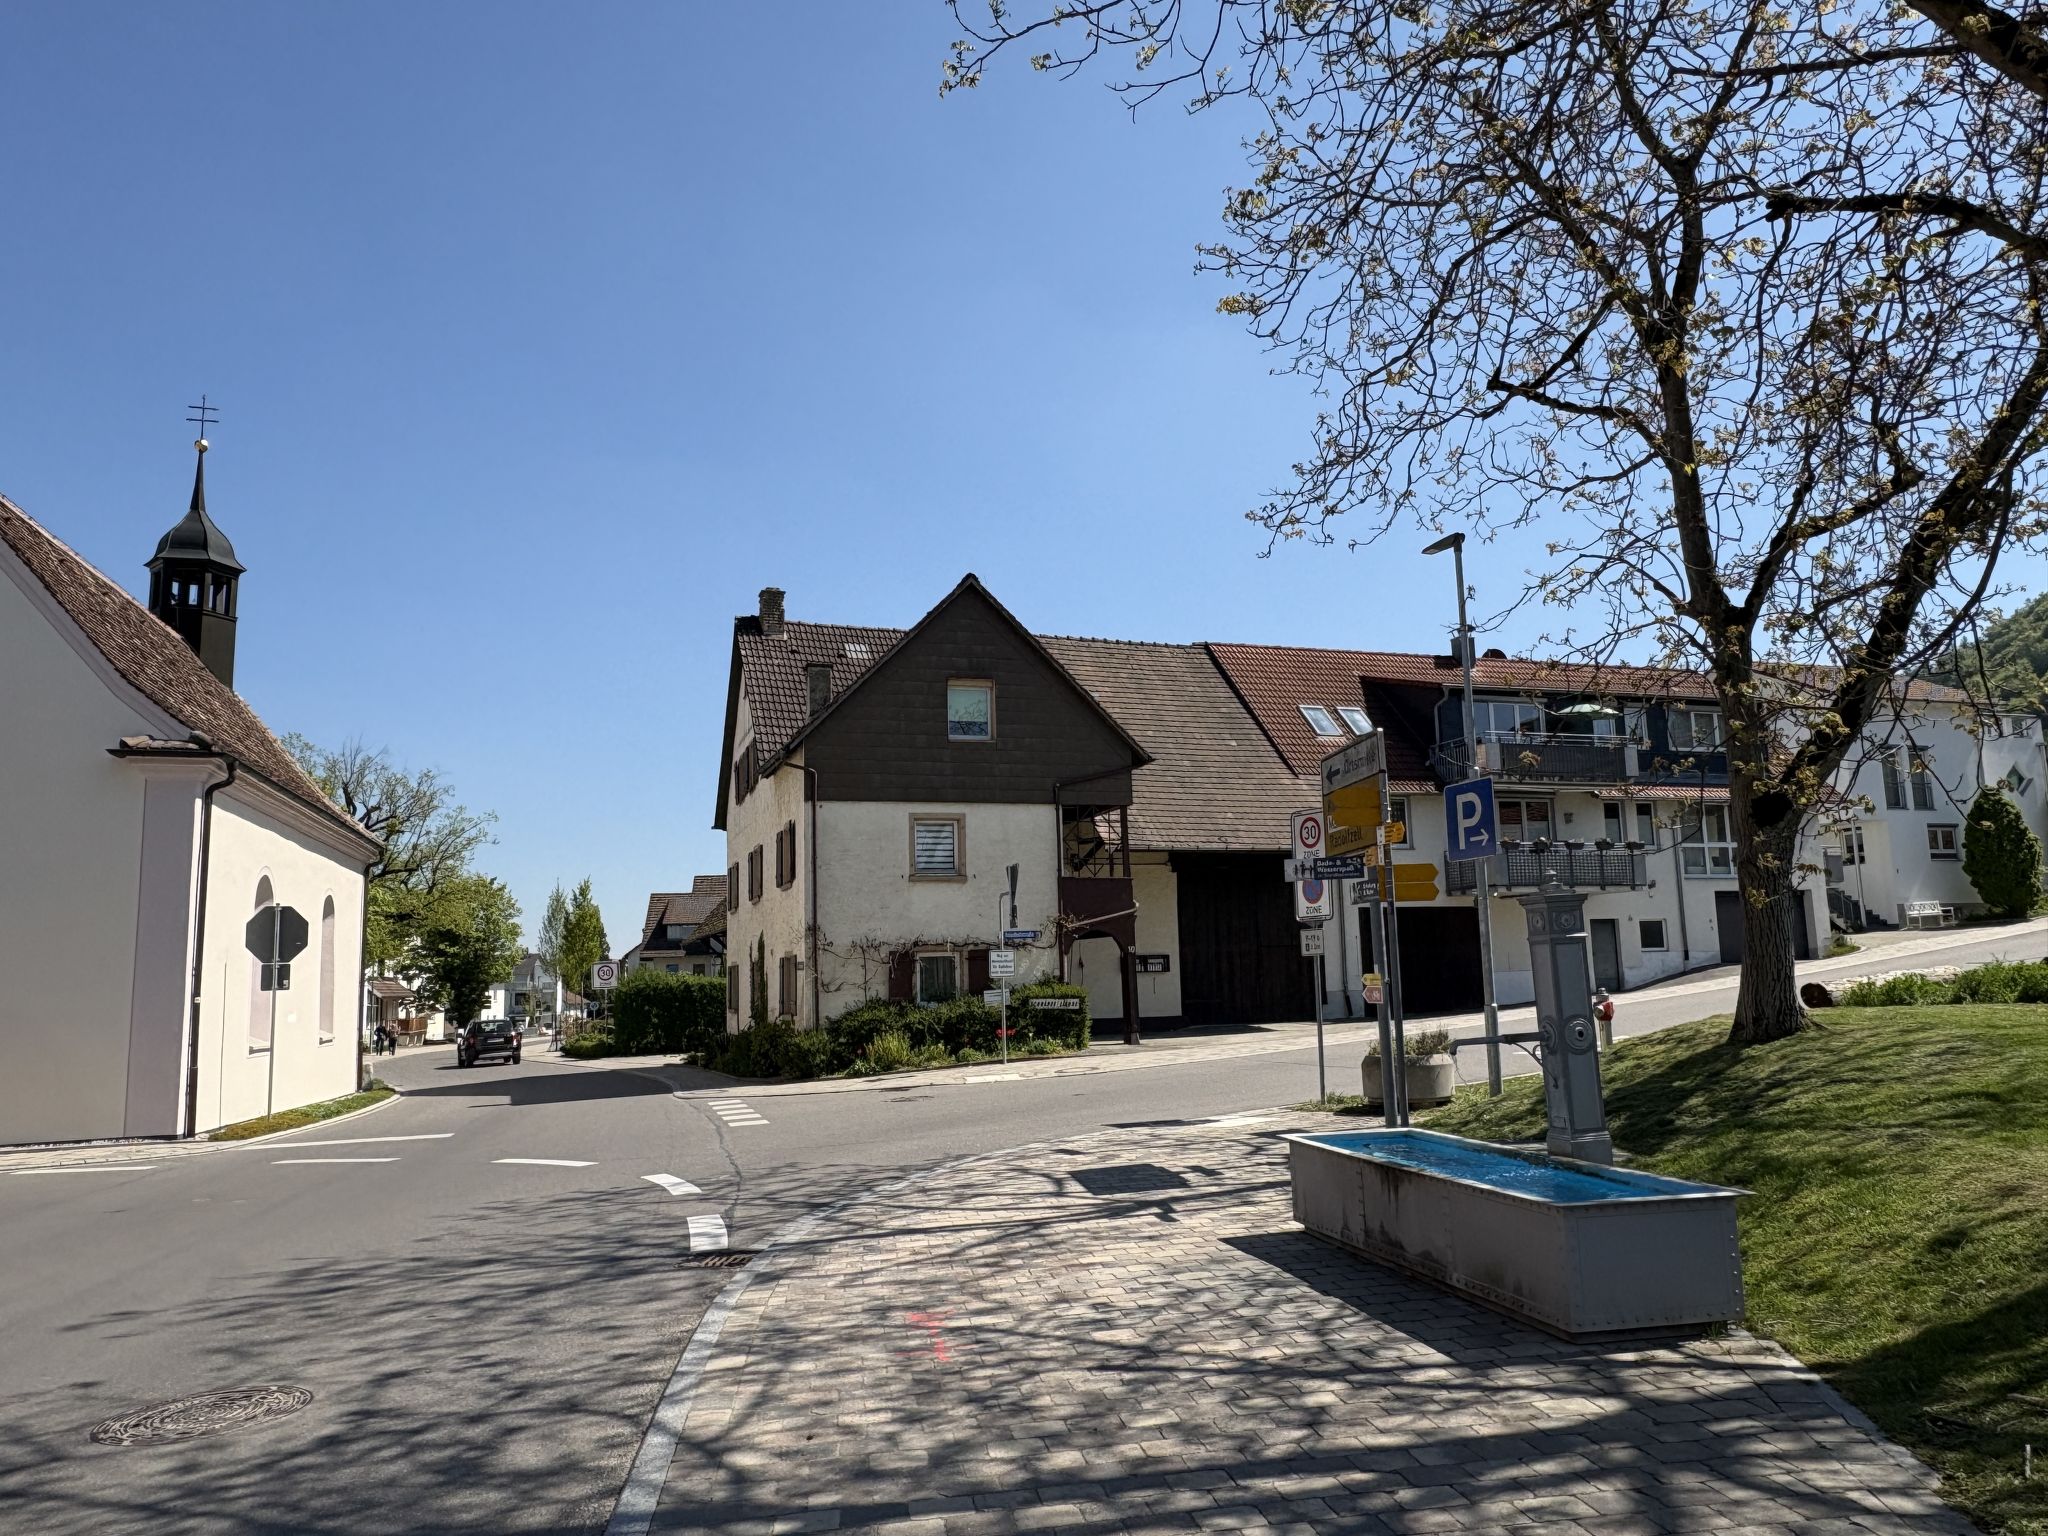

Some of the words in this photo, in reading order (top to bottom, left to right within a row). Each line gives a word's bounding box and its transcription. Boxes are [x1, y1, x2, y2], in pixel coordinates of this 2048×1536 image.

[1456, 792, 1482, 850] P
[1303, 825, 1317, 840] 30
[1303, 849, 1320, 859] ZONE
[1306, 905, 1322, 915] ZONE
[600, 969, 611, 977] 30
